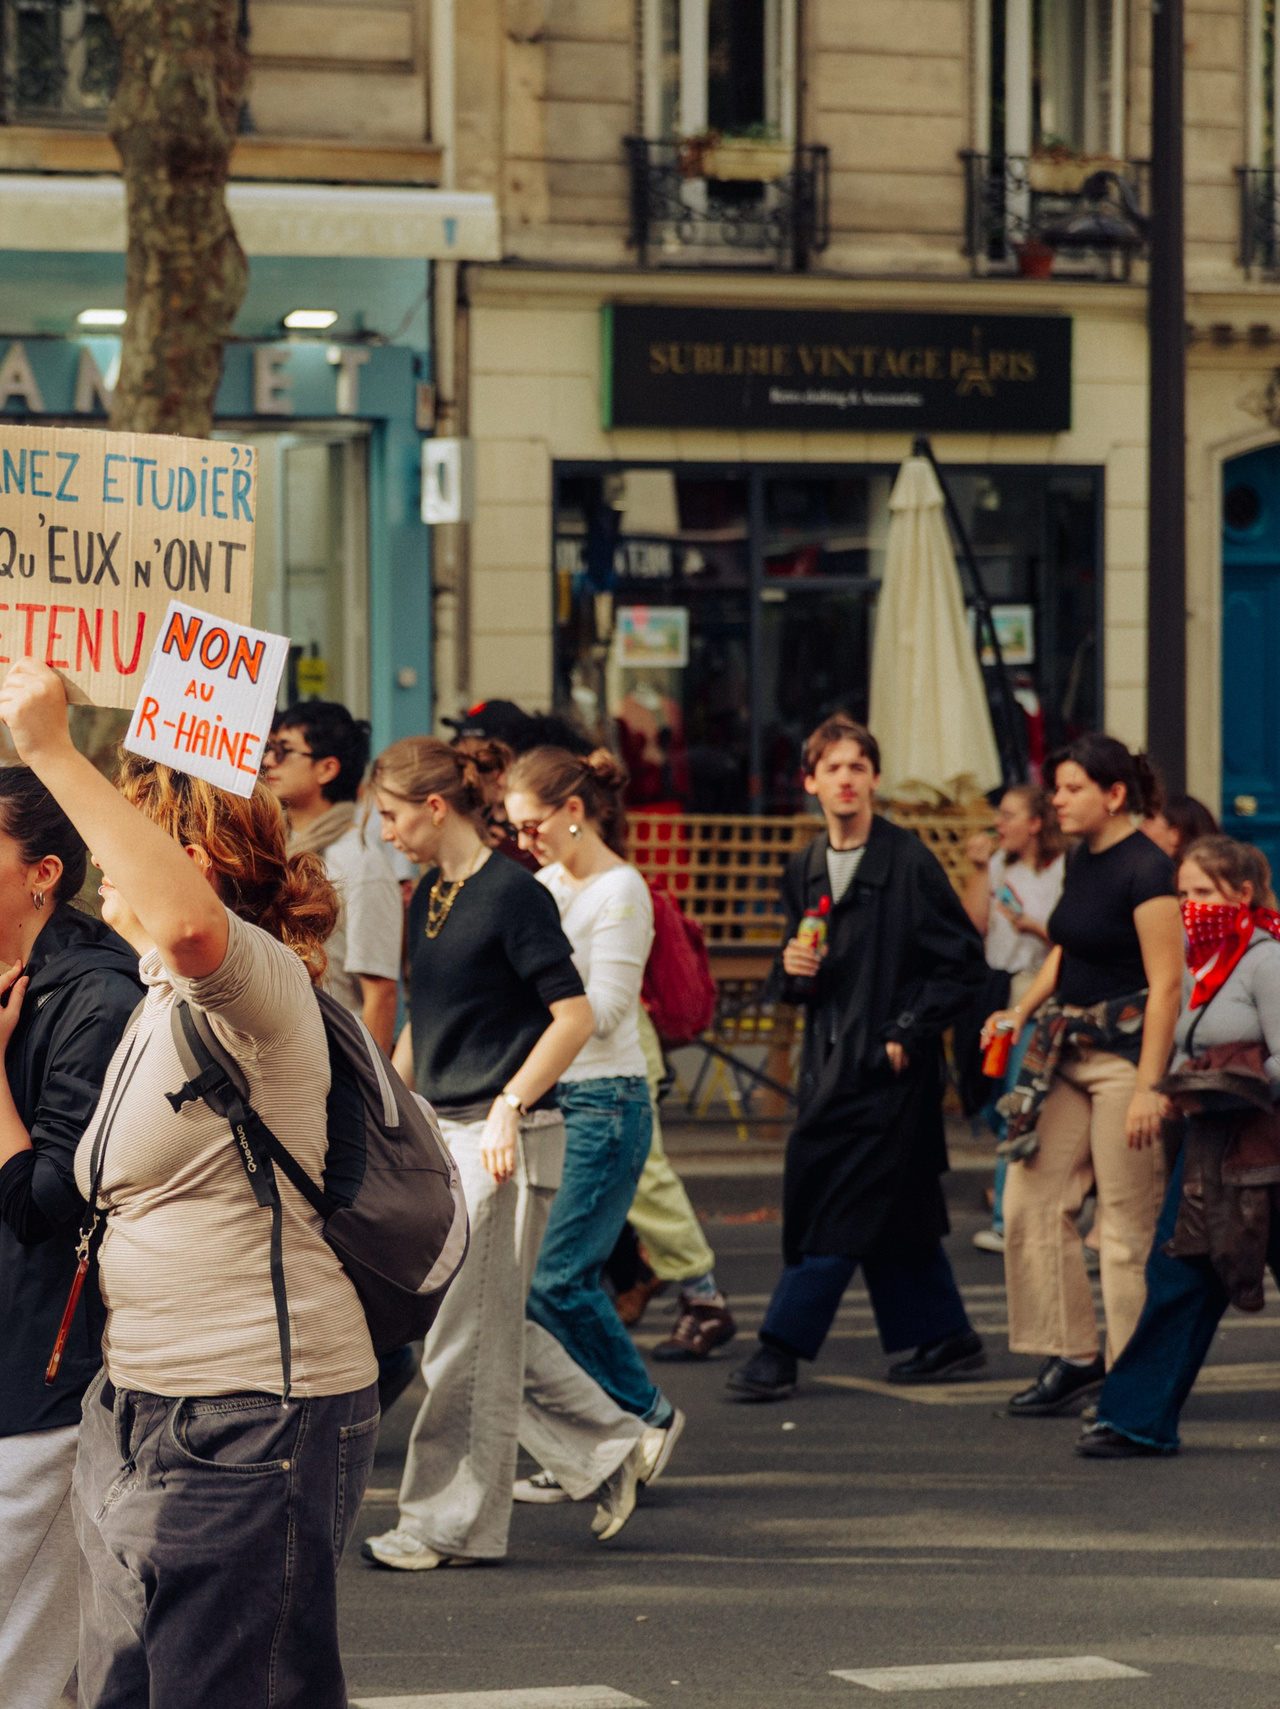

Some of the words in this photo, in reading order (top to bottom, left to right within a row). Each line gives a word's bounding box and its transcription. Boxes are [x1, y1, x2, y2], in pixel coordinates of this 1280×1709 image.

[648, 342, 791, 376] SUBLIME
[797, 345, 945, 380] VINTAGE
[949, 334, 1037, 396] PARIS
[162, 612, 266, 685] NON
[184, 680, 215, 702] AU
[236, 1124, 257, 1173] Quechua
